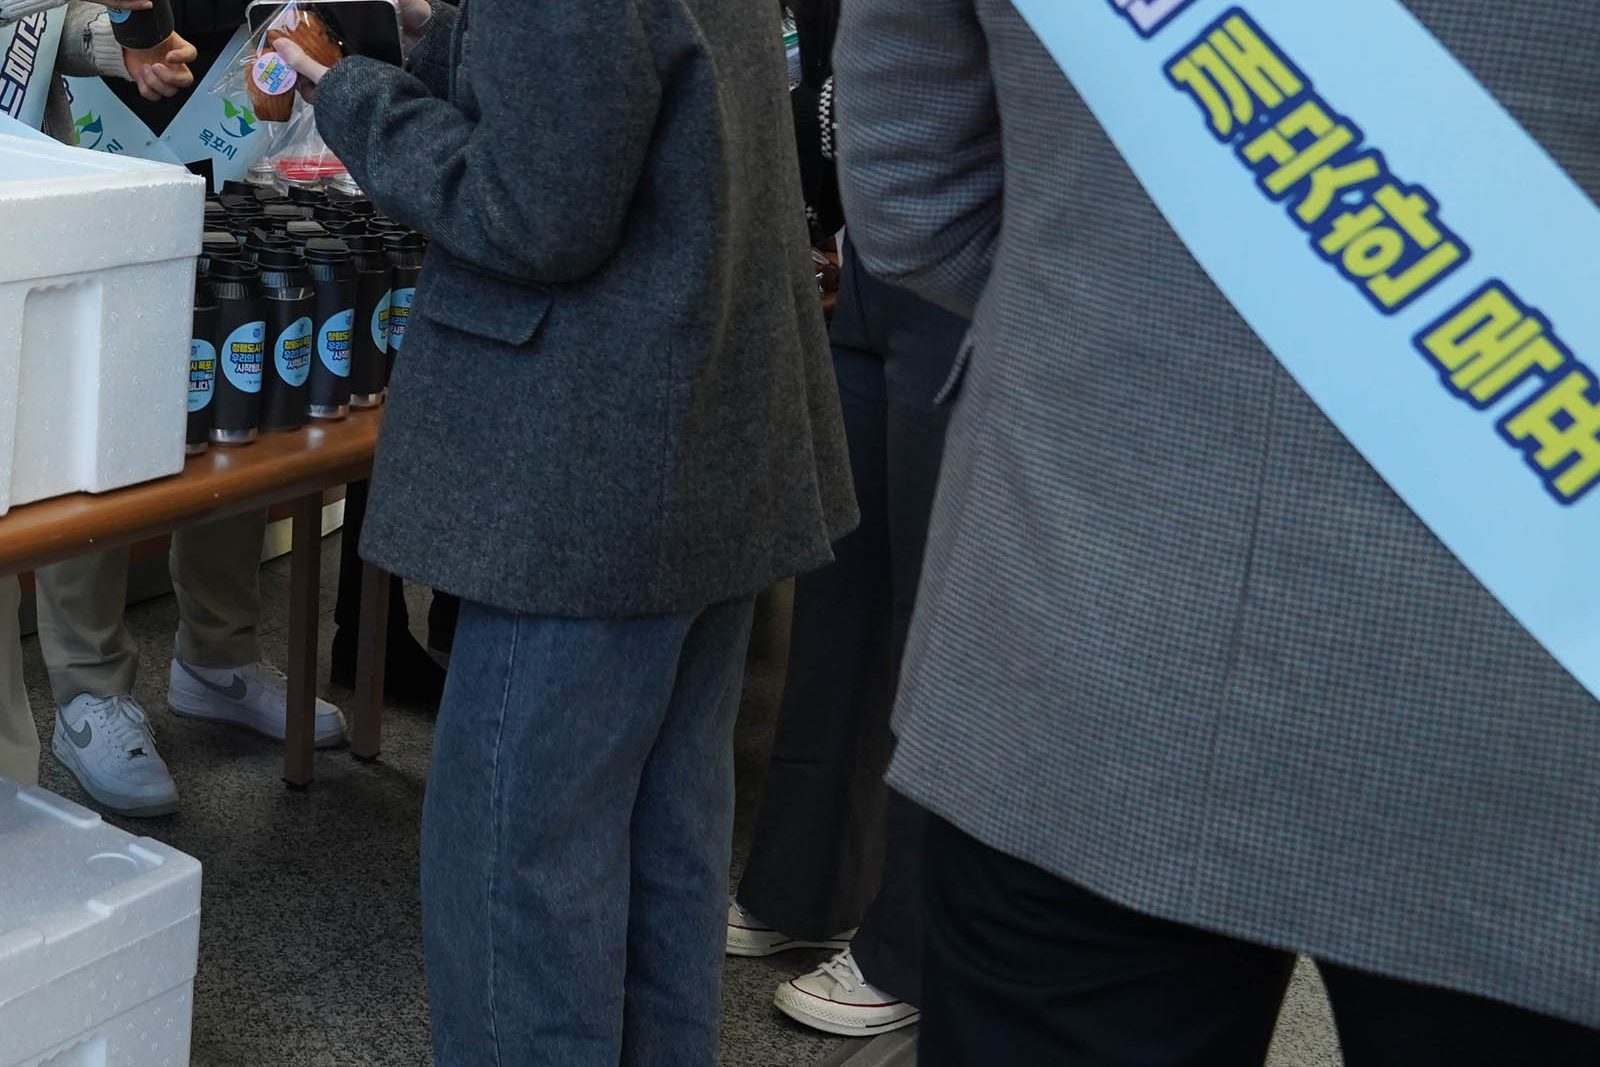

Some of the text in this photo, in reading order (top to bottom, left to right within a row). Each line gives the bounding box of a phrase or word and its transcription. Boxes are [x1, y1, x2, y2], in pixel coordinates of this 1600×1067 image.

[198, 128, 239, 162] 목포시
[1166, 5, 1471, 316] 깨끗한
[1413, 280, 1600, 506] 목포
